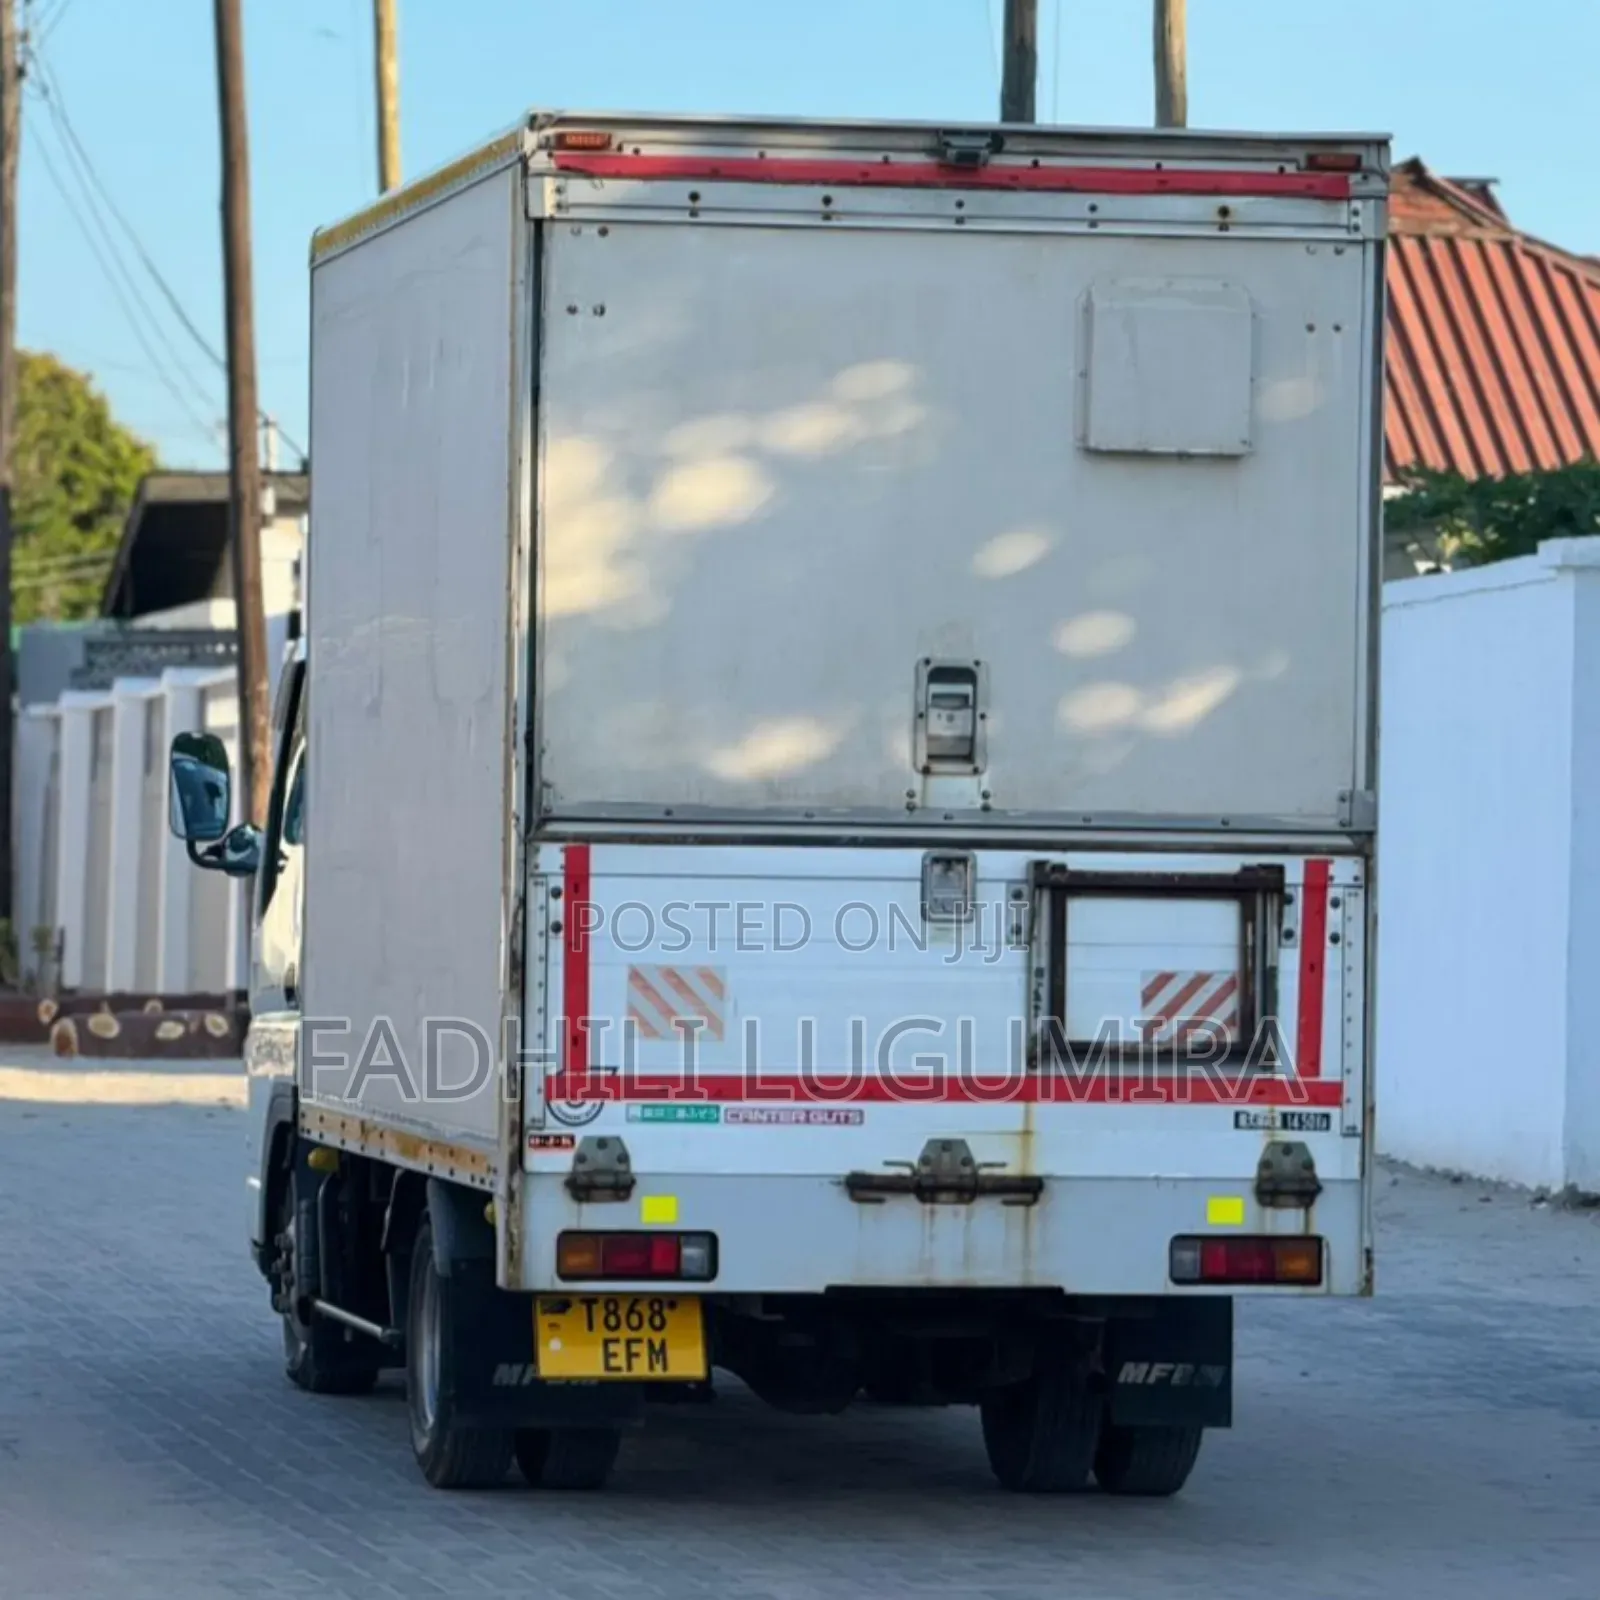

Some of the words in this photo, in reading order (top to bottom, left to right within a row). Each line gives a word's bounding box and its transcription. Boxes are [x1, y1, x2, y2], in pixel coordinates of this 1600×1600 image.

[726, 1109, 806, 1124] CANTER
[808, 1110, 862, 1125] GUTS
[579, 1298, 668, 1332] T868
[602, 1338, 668, 1372] EFM
